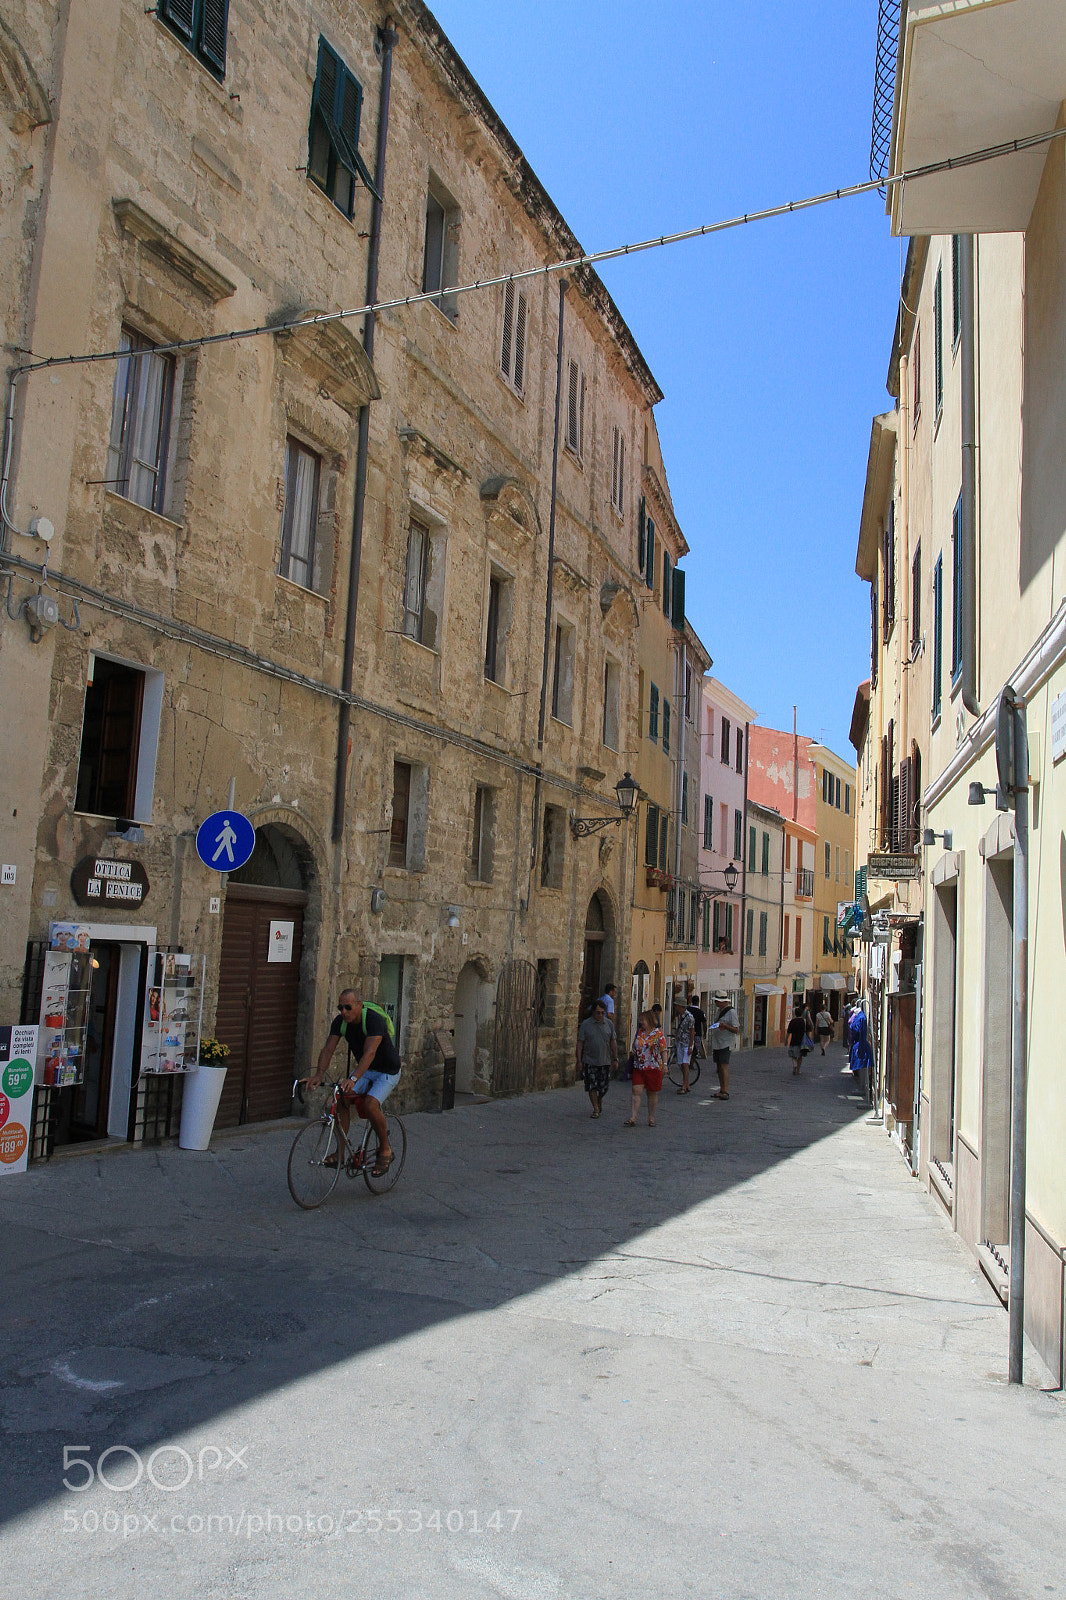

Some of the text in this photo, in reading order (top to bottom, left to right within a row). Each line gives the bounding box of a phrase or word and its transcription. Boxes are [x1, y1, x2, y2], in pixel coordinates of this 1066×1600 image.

[870, 857, 915, 867] OREFICERIA
[95, 863, 131, 878] OTTICA
[88, 882, 142, 897] LA FENICE
[13, 1042, 35, 1050] completi
